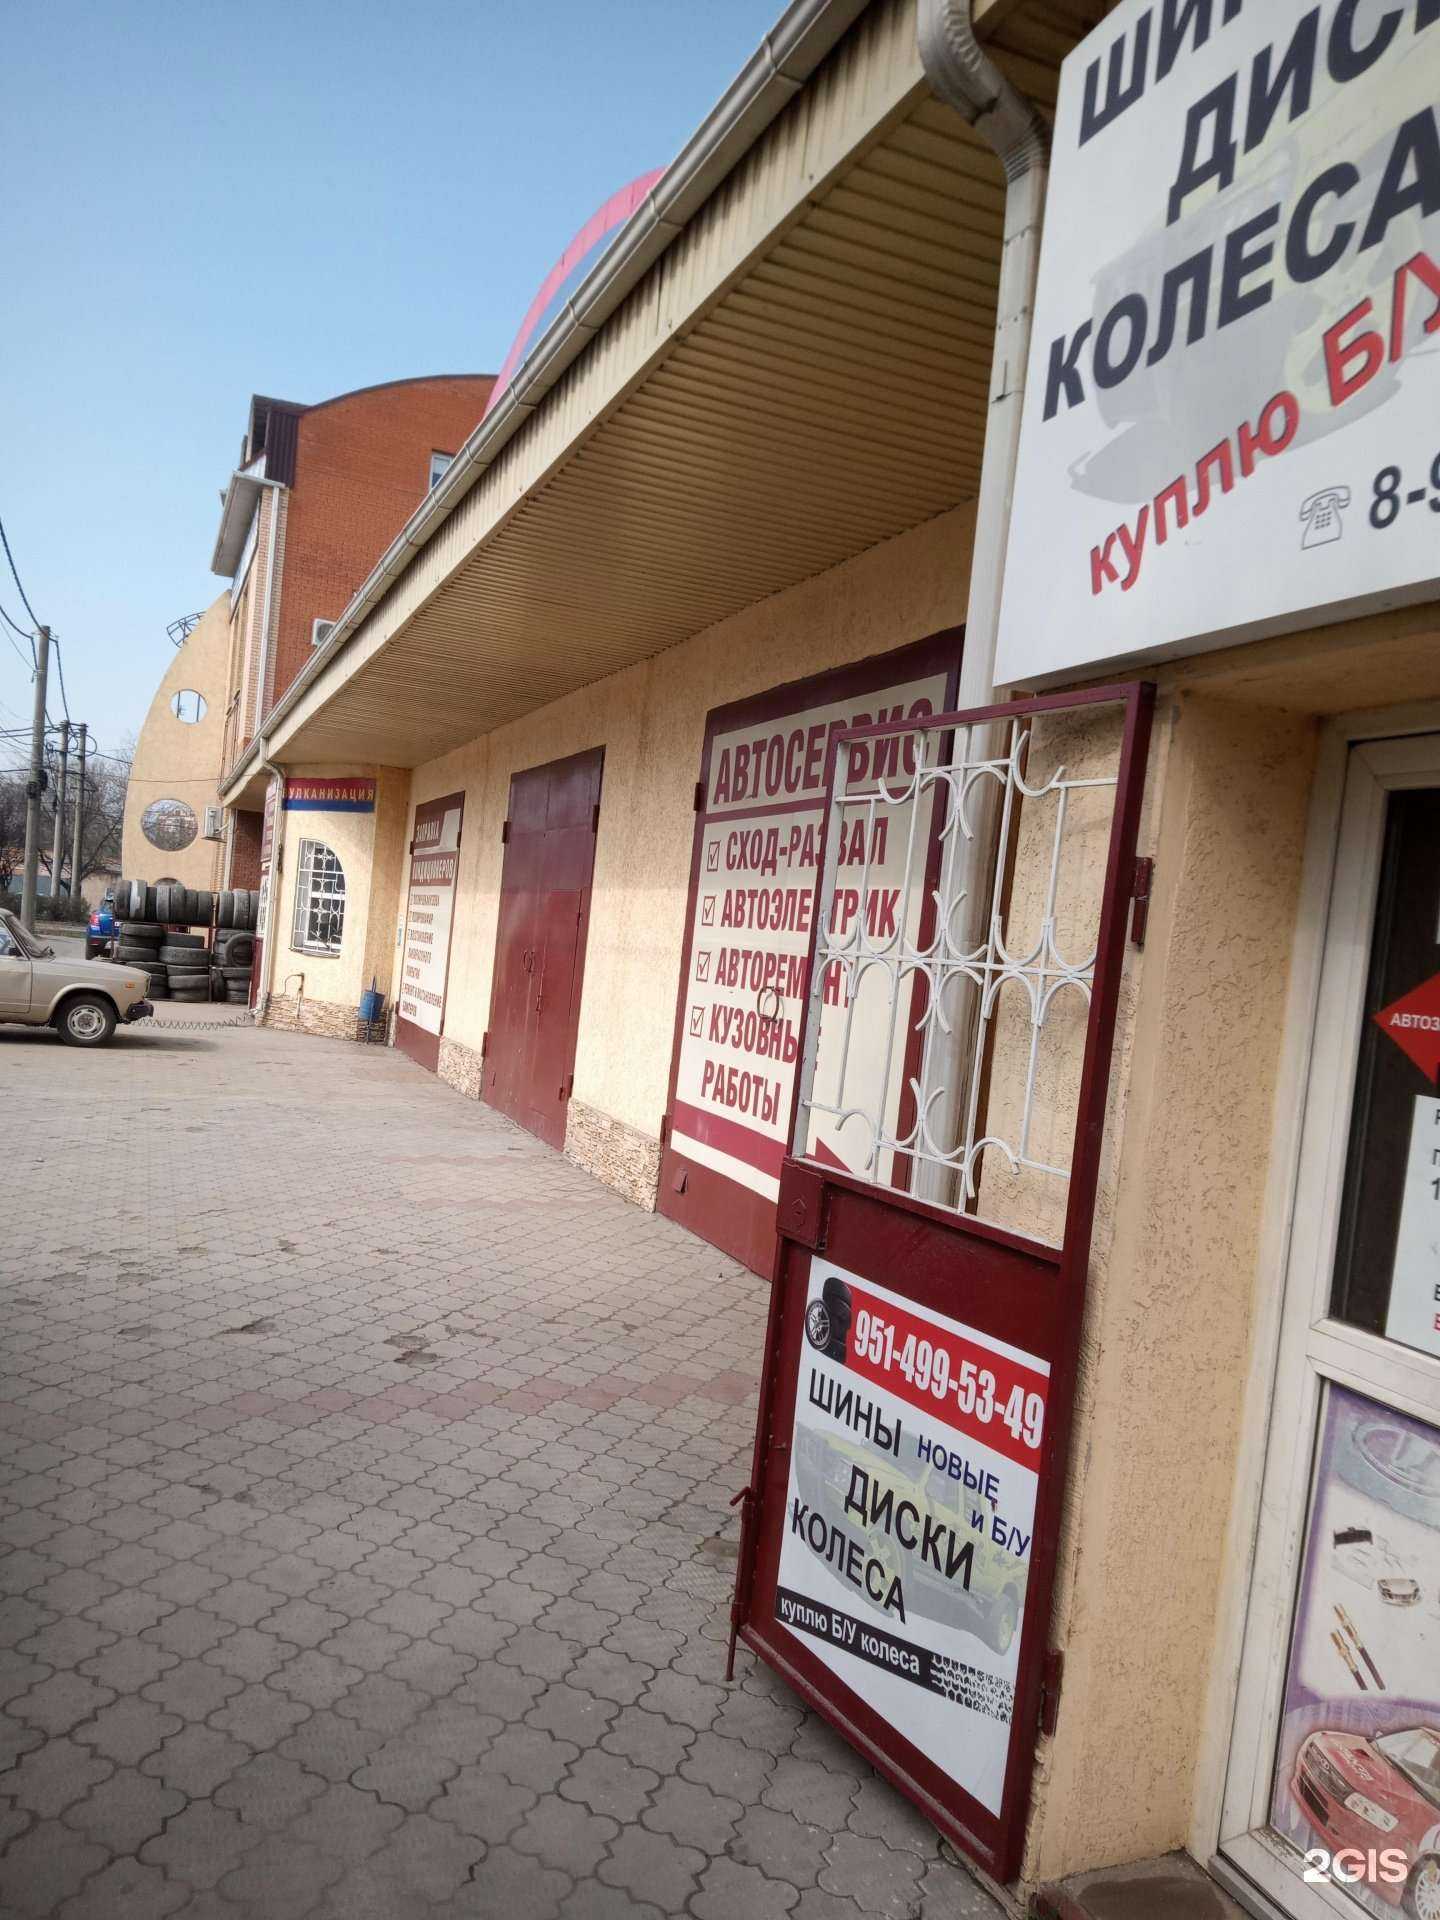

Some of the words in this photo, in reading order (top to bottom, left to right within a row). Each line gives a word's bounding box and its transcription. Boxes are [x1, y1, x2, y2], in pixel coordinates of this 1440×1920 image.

[1079, 0, 1242, 149] ШИ
[1166, 0, 1440, 227] ДИС
[1042, 106, 1440, 423] КОЛЕСА
[1090, 390, 1300, 596] куплю
[720, 888, 901, 938] АВТОЭЛЕТРИК
[709, 1003, 822, 1072] КУЗОВНЫ
[715, 947, 853, 1009] АВТОРЕМН
[700, 1059, 782, 1126] РАБОТЫ
[808, 1367, 902, 1458] ШИНЫ
[917, 1434, 1000, 1501] НОВЫЕ
[854, 1308, 1045, 1450] 951-499-53-49
[791, 1497, 908, 1625] КОЛЕСА
[844, 1464, 974, 1593] ДИСКИ
[991, 1514, 1031, 1558] Б/У
[781, 1597, 828, 1633] куплю
[831, 1612, 857, 1645] Б/У
[860, 1631, 921, 1677] колеса
